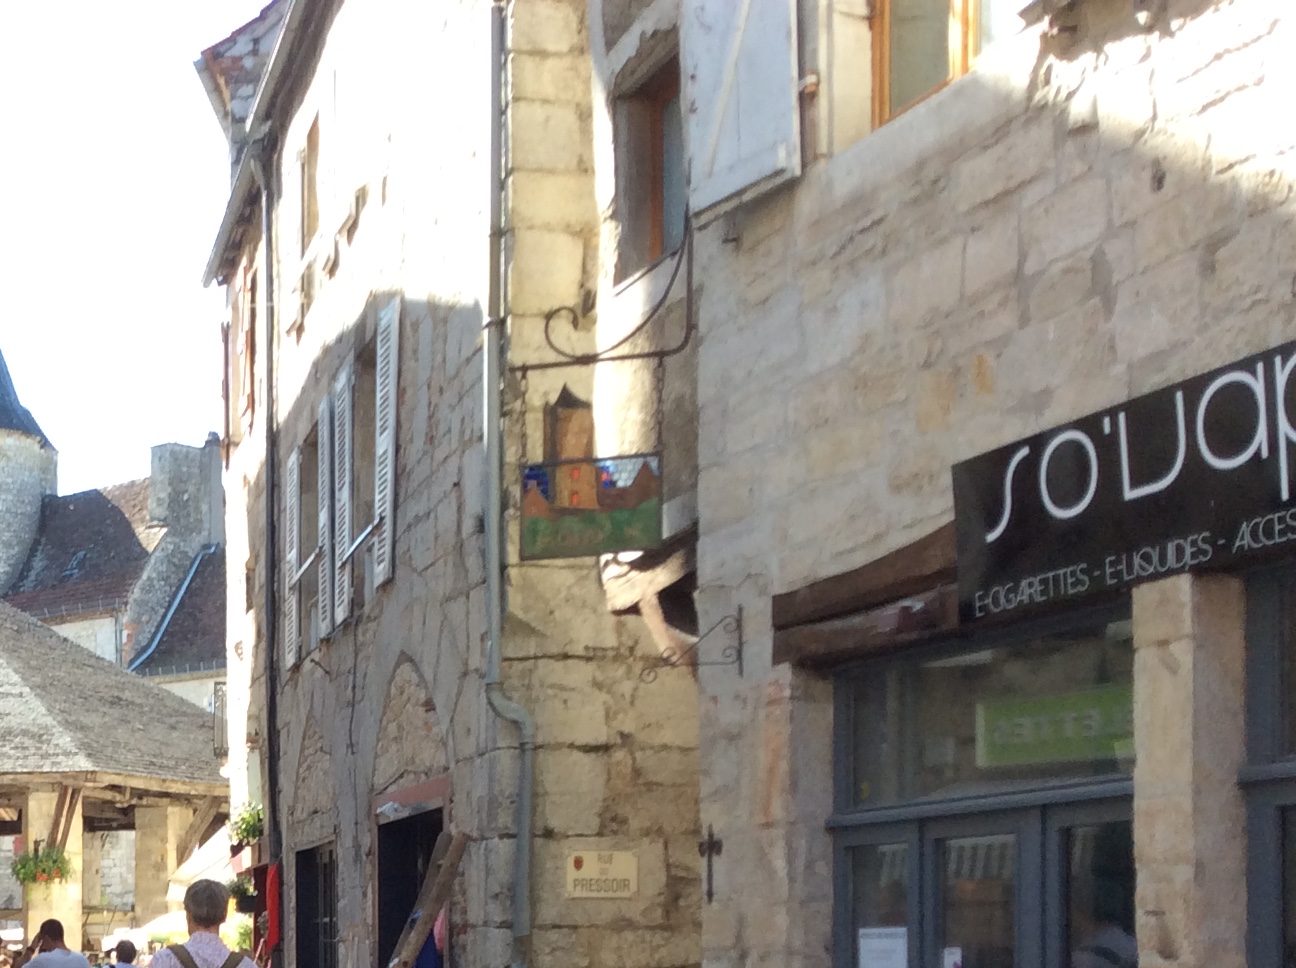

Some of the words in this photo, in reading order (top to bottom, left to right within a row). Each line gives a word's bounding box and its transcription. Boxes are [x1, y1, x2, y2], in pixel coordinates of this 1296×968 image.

[974, 563, 1091, 618] E-CIGARETTES
[1104, 531, 1213, 586] E-LIQUIDES
[597, 852, 614, 865] RUE
[573, 877, 631, 893] PRESSOIR
